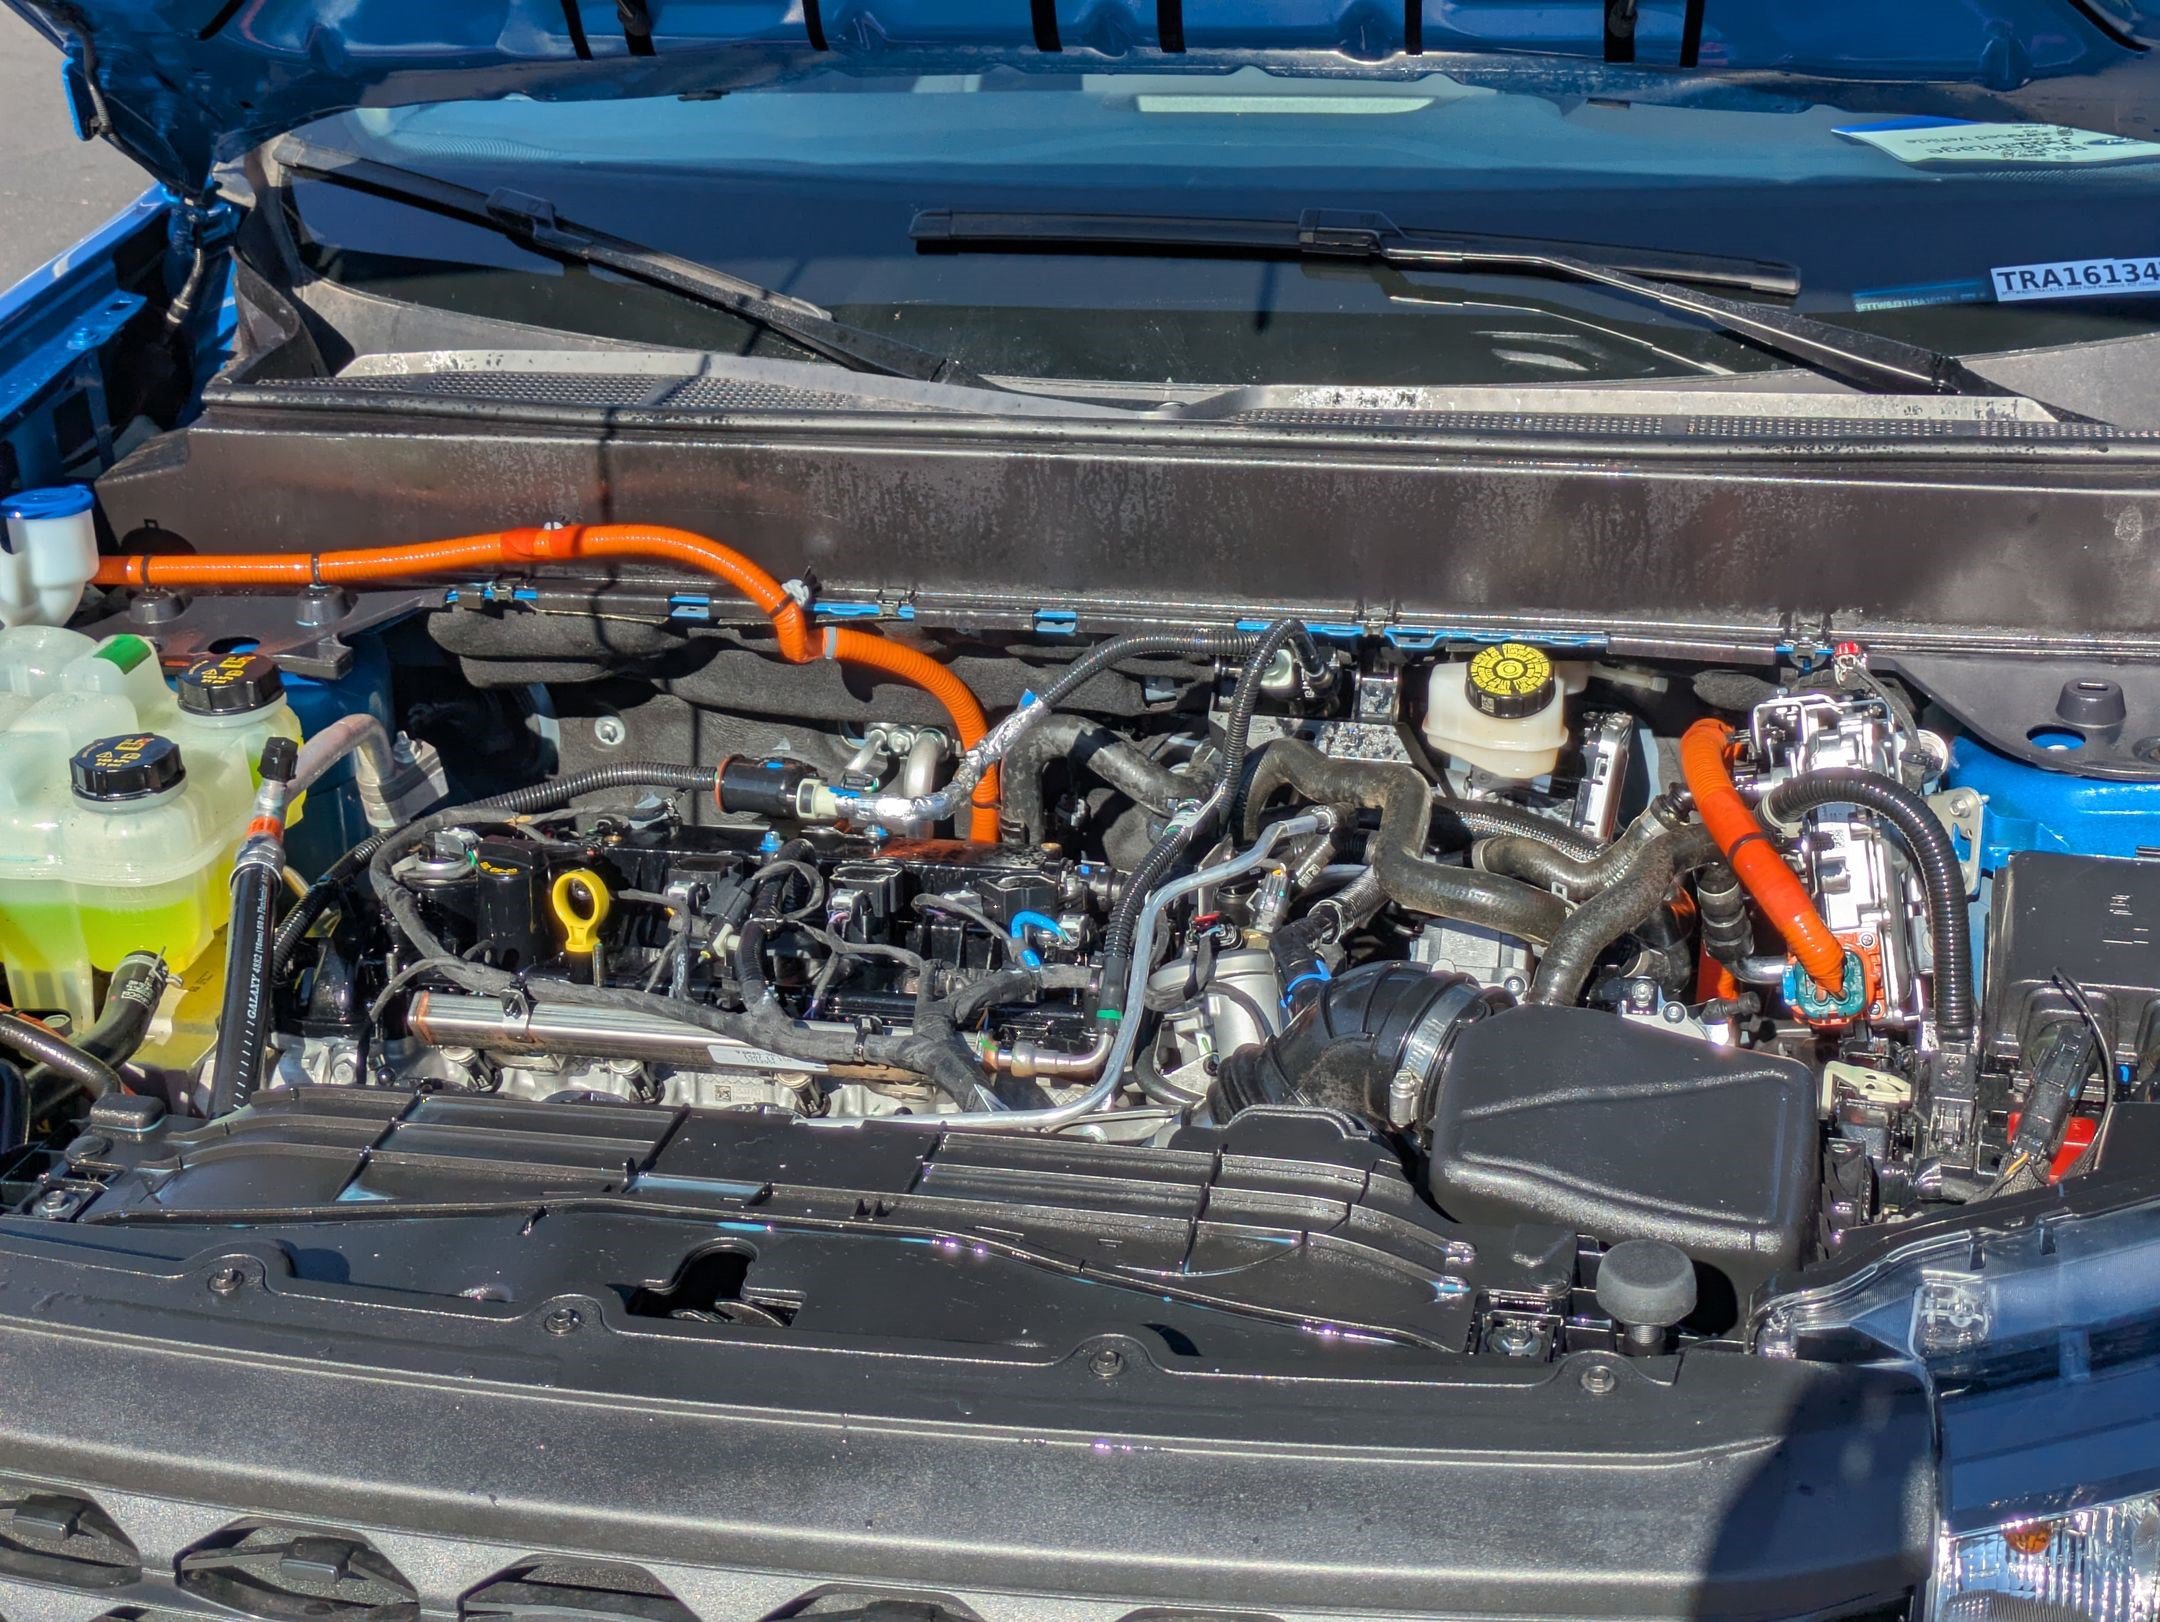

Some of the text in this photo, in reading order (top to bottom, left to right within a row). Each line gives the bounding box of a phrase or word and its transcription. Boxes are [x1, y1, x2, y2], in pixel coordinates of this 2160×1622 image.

[1997, 262, 2160, 291] TRA16134
[252, 953, 263, 974] 4882
[246, 974, 261, 1020] GALAXY
